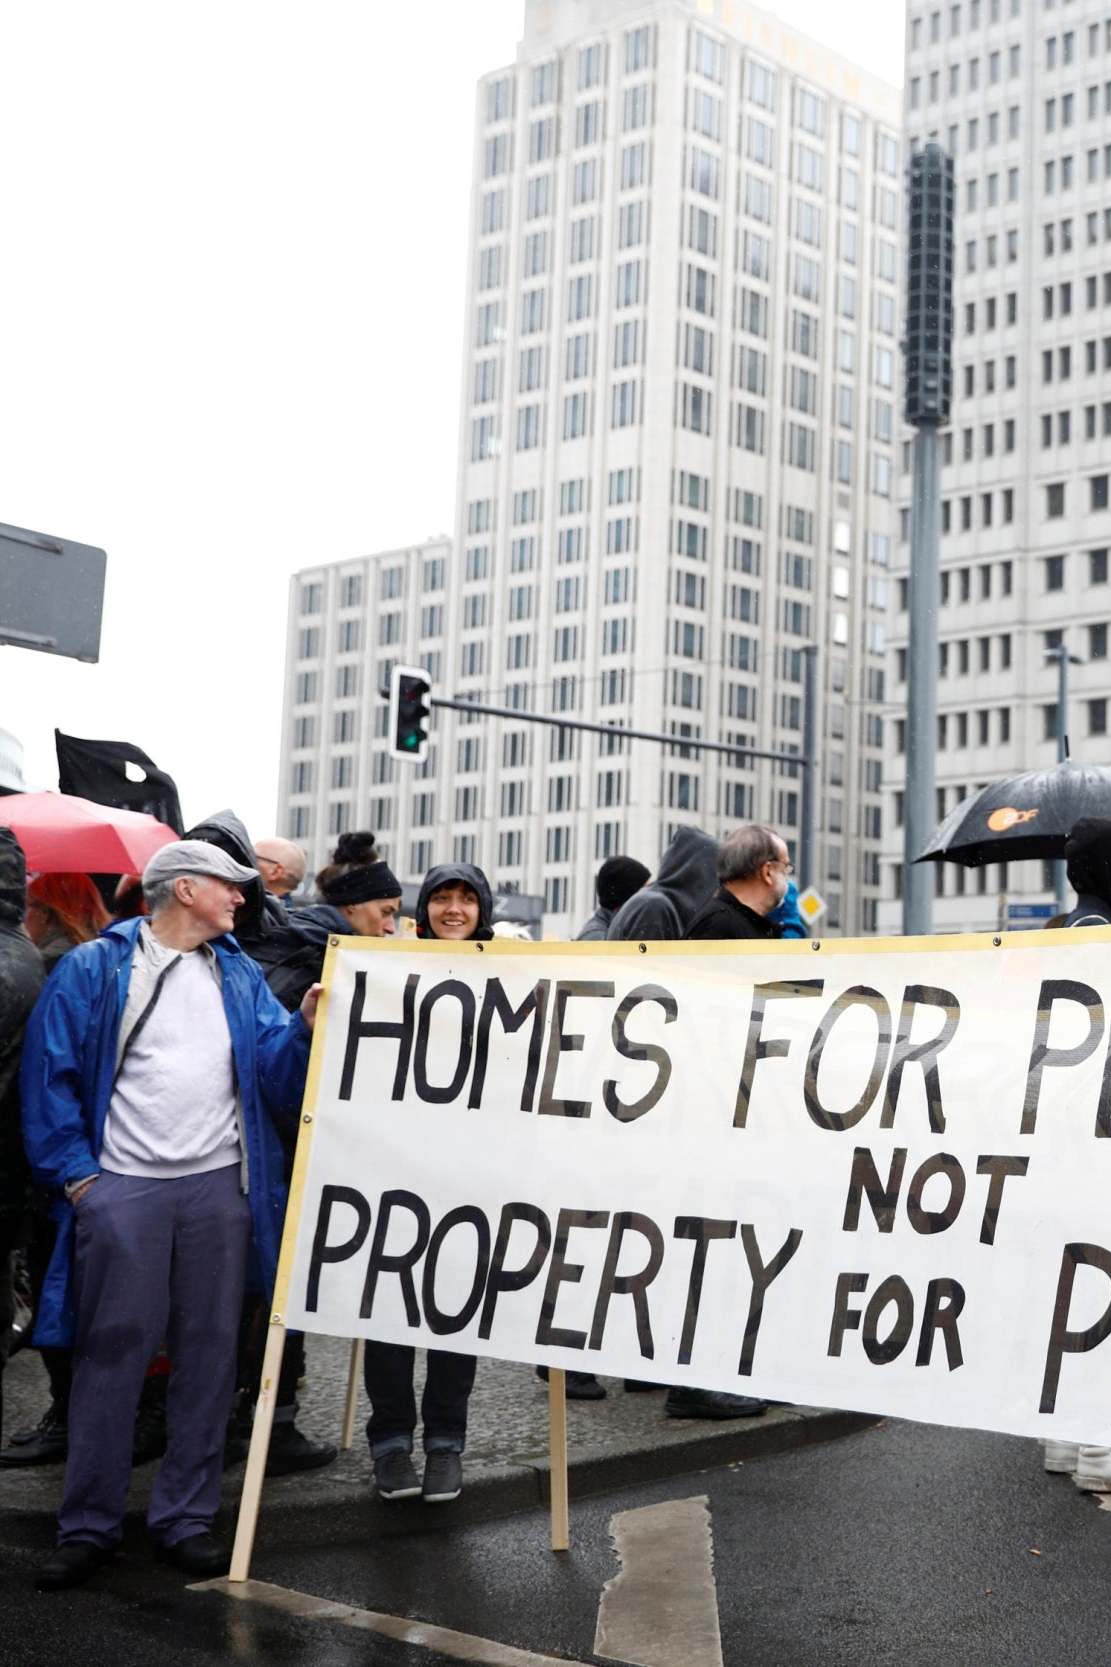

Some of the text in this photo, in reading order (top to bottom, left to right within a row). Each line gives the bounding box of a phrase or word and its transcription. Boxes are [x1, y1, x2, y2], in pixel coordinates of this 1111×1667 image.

[339, 971, 679, 1123] HOMES
[733, 978, 961, 1134] FOR
[842, 1146, 1030, 1245] NOT
[304, 1184, 803, 1377] PROPERTY
[827, 1272, 966, 1372] FOR
